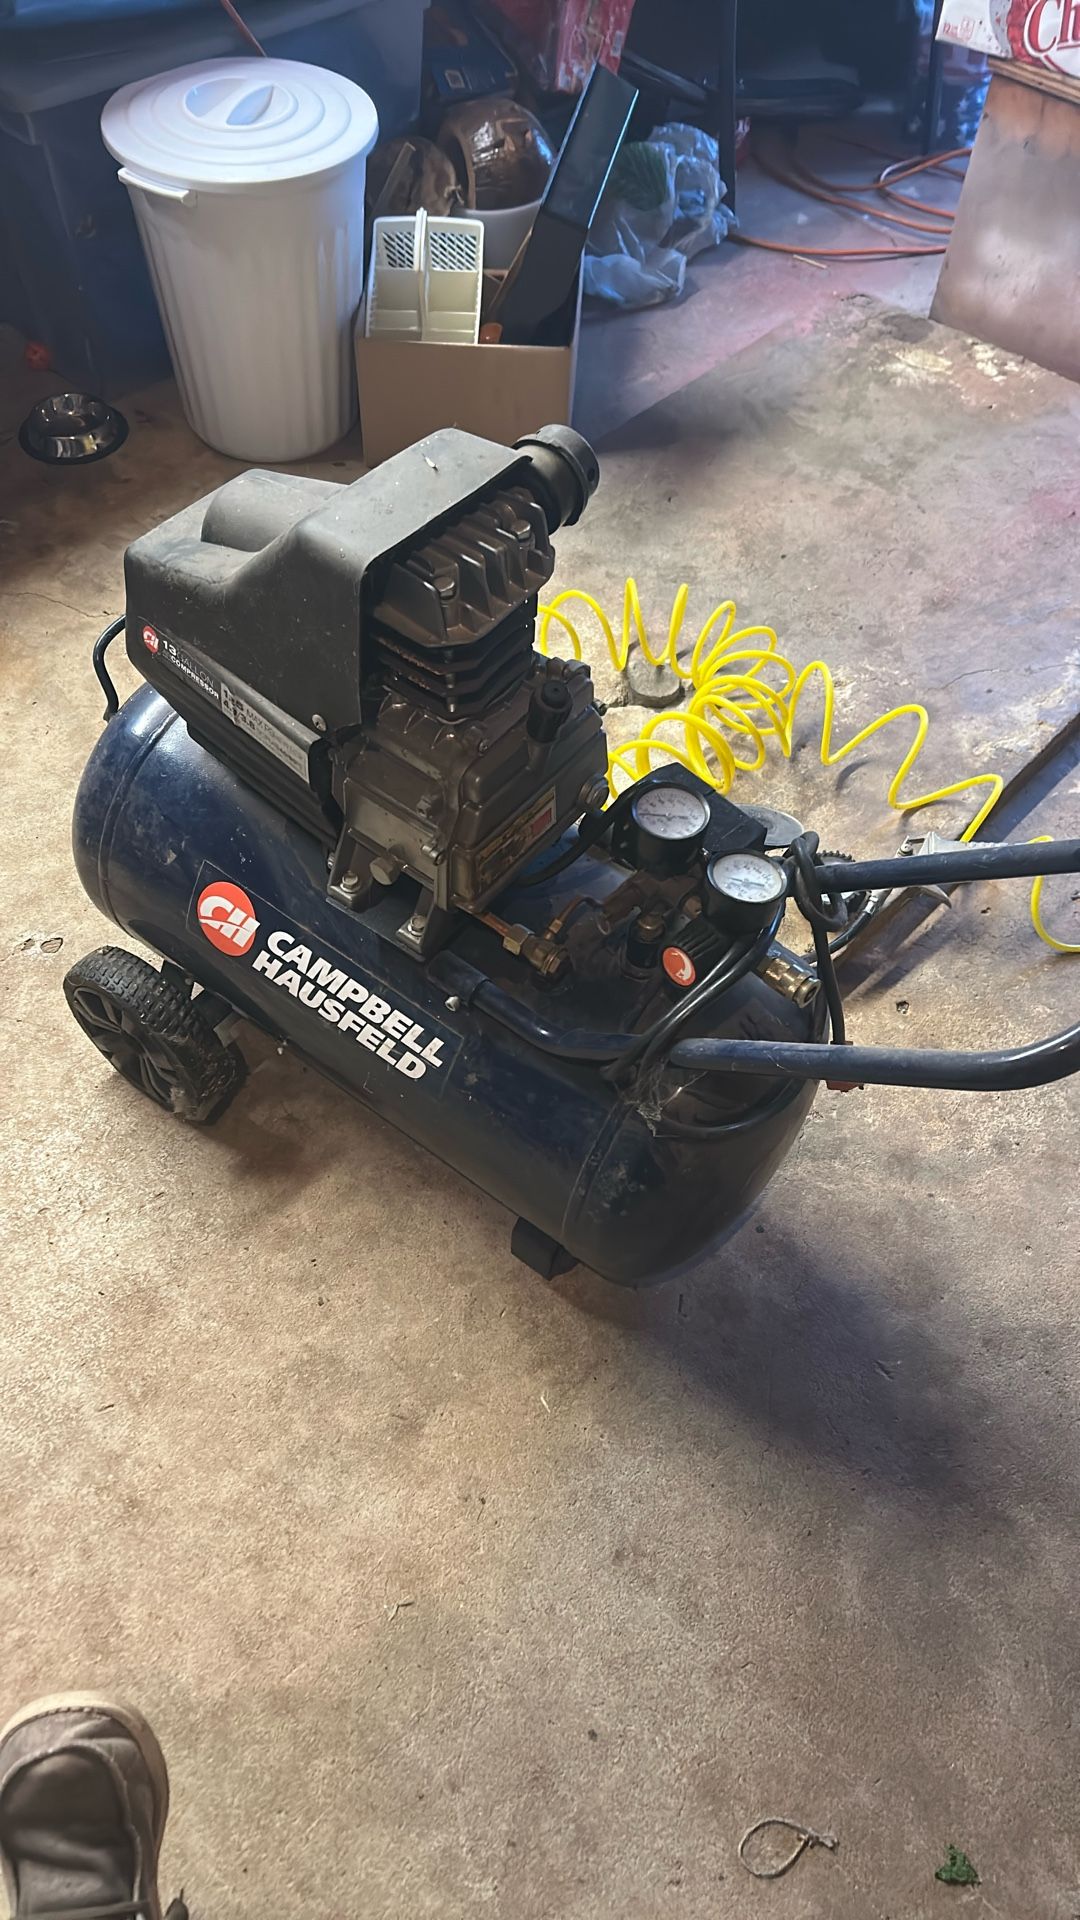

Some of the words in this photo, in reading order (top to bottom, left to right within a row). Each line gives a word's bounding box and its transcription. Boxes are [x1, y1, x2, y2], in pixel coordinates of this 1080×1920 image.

[163, 640, 177, 656] 13
[170, 655, 219, 700] COMPRESSOR
[199, 896, 261, 948] CH
[252, 950, 427, 1079] HAUSFELD
[267, 930, 445, 1068] CAMPBELL
